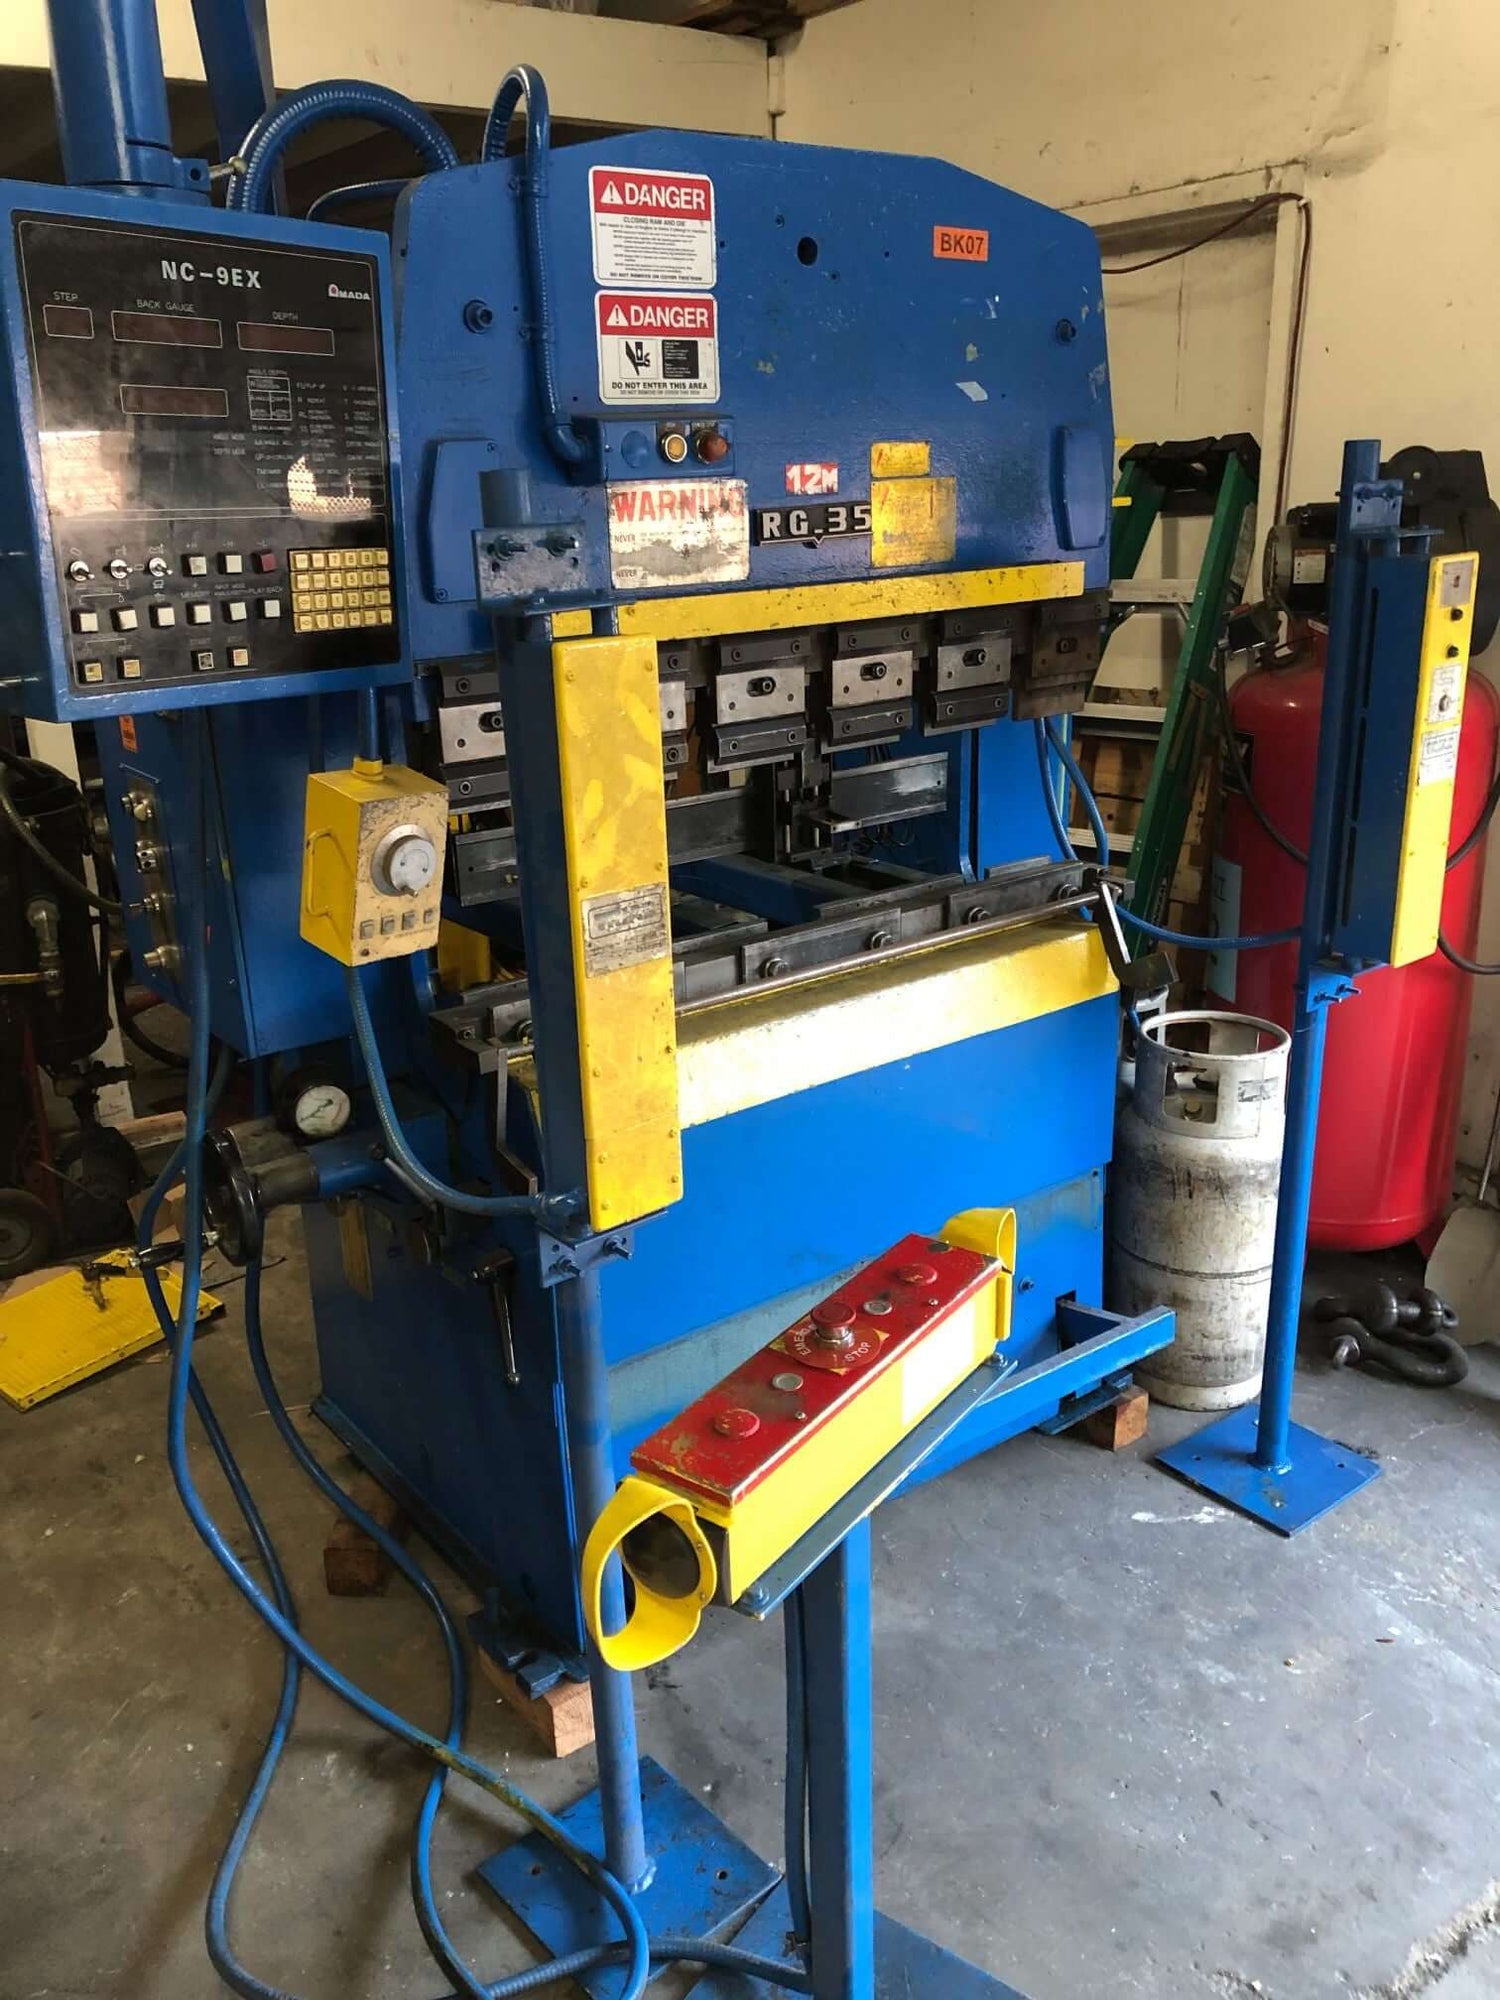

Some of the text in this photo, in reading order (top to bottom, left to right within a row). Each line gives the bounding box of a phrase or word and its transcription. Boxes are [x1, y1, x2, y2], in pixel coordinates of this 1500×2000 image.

[624, 182, 706, 210] DANGER
[940, 233, 984, 255] BK07
[161, 260, 262, 289] NC-9EX
[53, 291, 79, 302] STEP
[136, 299, 195, 312] BACK GAUGE
[272, 311, 298, 321] DEPTH
[630, 305, 709, 328] DANGER
[669, 382, 687, 390] THIS
[688, 382, 708, 390] AREA
[612, 487, 744, 523] WARNING
[844, 1341, 873, 1363] STOP
